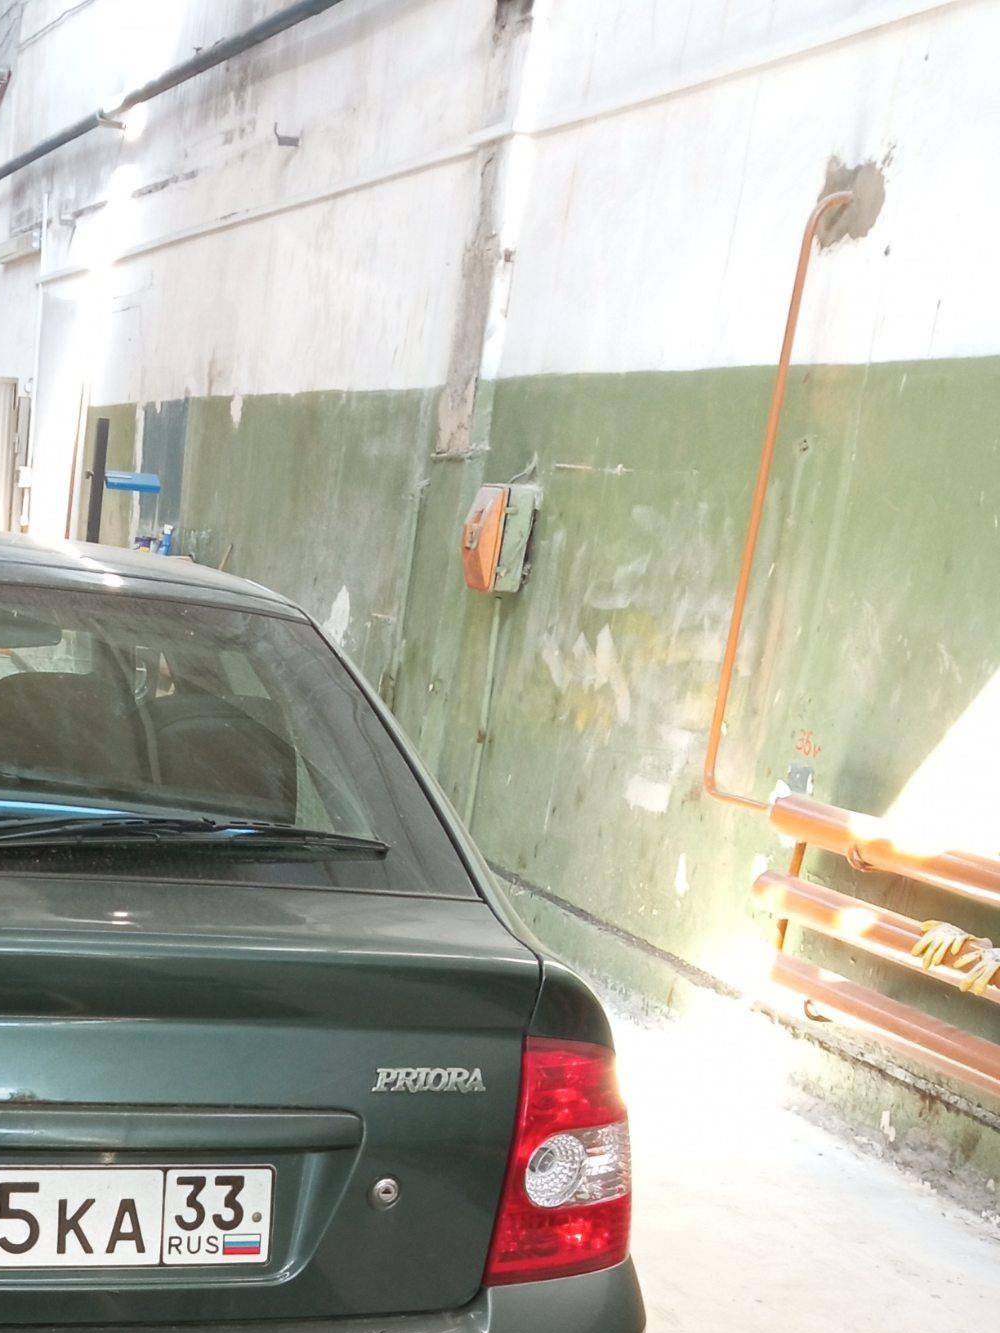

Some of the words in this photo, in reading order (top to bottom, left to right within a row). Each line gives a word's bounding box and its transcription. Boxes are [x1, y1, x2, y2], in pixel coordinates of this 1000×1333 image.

[371, 1067, 487, 1093] PRIORA
[174, 1175, 245, 1231] 33
[168, 1235, 219, 1255] RUS
